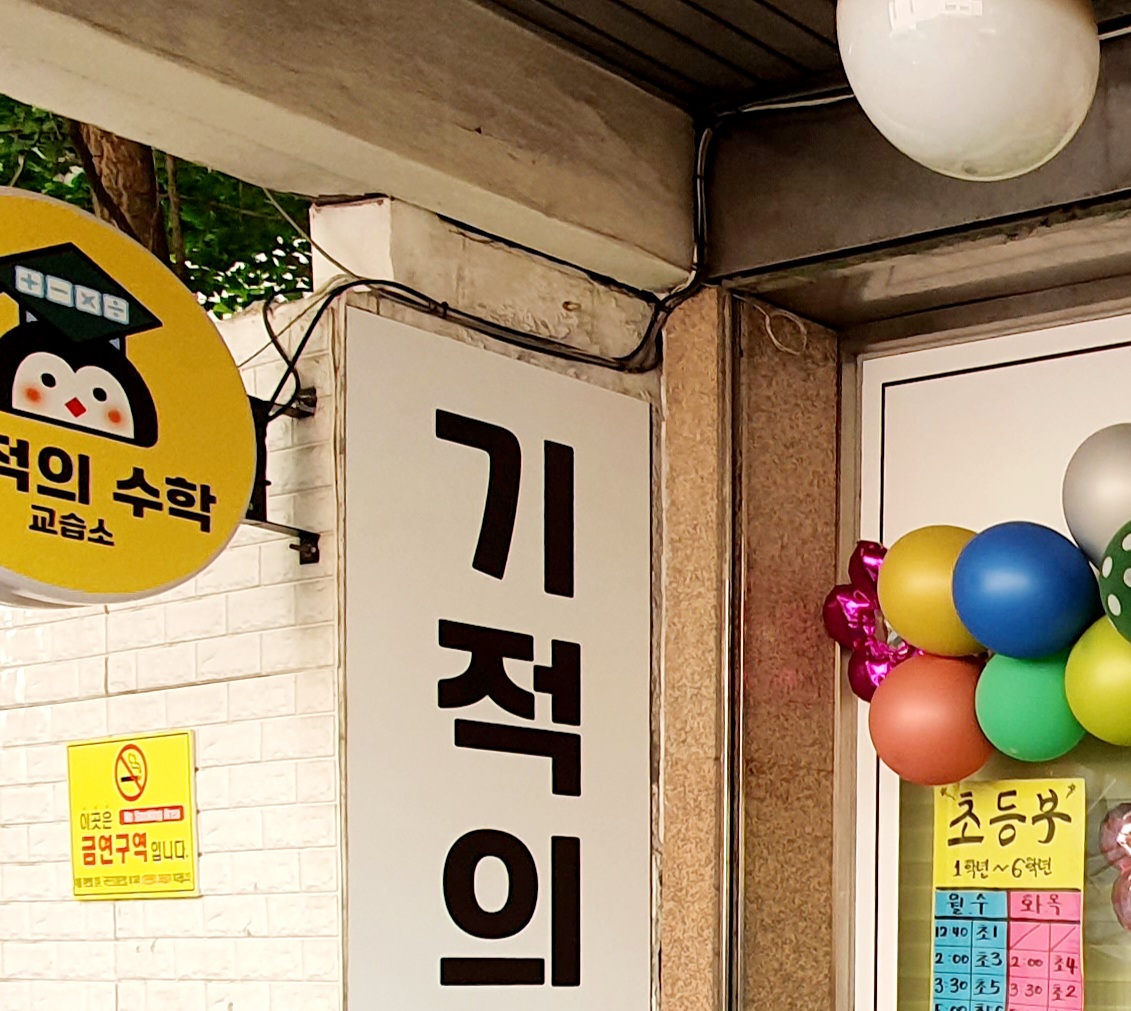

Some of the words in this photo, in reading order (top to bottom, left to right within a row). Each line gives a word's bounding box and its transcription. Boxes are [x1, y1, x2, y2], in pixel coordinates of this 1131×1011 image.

[113, 466, 217, 533] 수학
[28, 504, 115, 547] 교습소
[435, 408, 582, 988] 기적의
[80, 810, 112, 830] 이곳은
[947, 788, 1072, 847] 초등부
[81, 832, 148, 866] 금연구역
